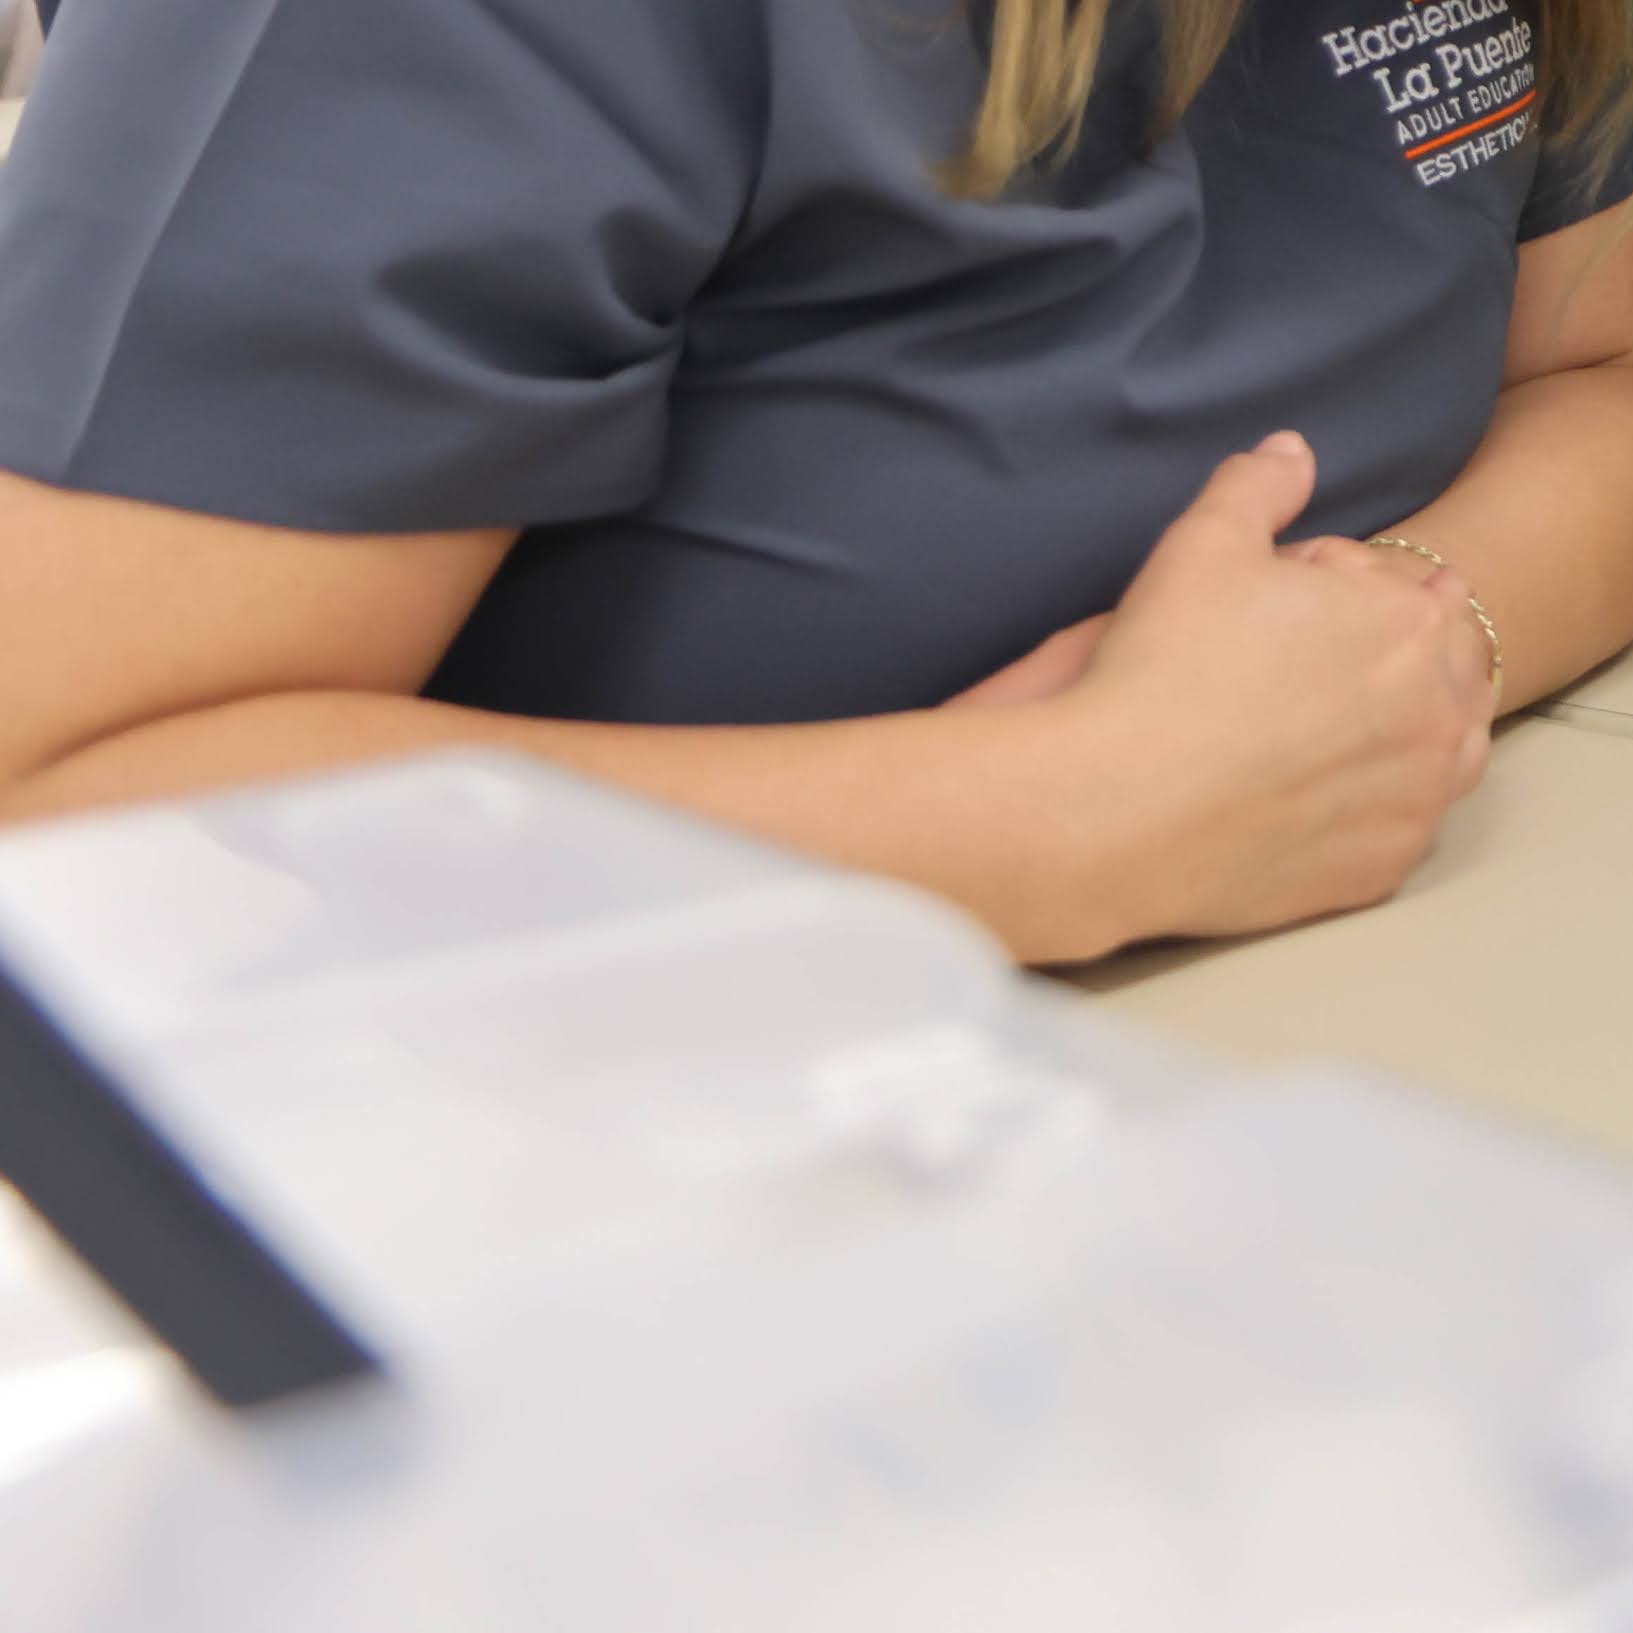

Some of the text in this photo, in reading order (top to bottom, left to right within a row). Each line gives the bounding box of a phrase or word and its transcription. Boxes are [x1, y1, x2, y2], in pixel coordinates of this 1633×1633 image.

[1373, 17, 1532, 113] La Puente
[1396, 98, 1464, 144] ADULT
